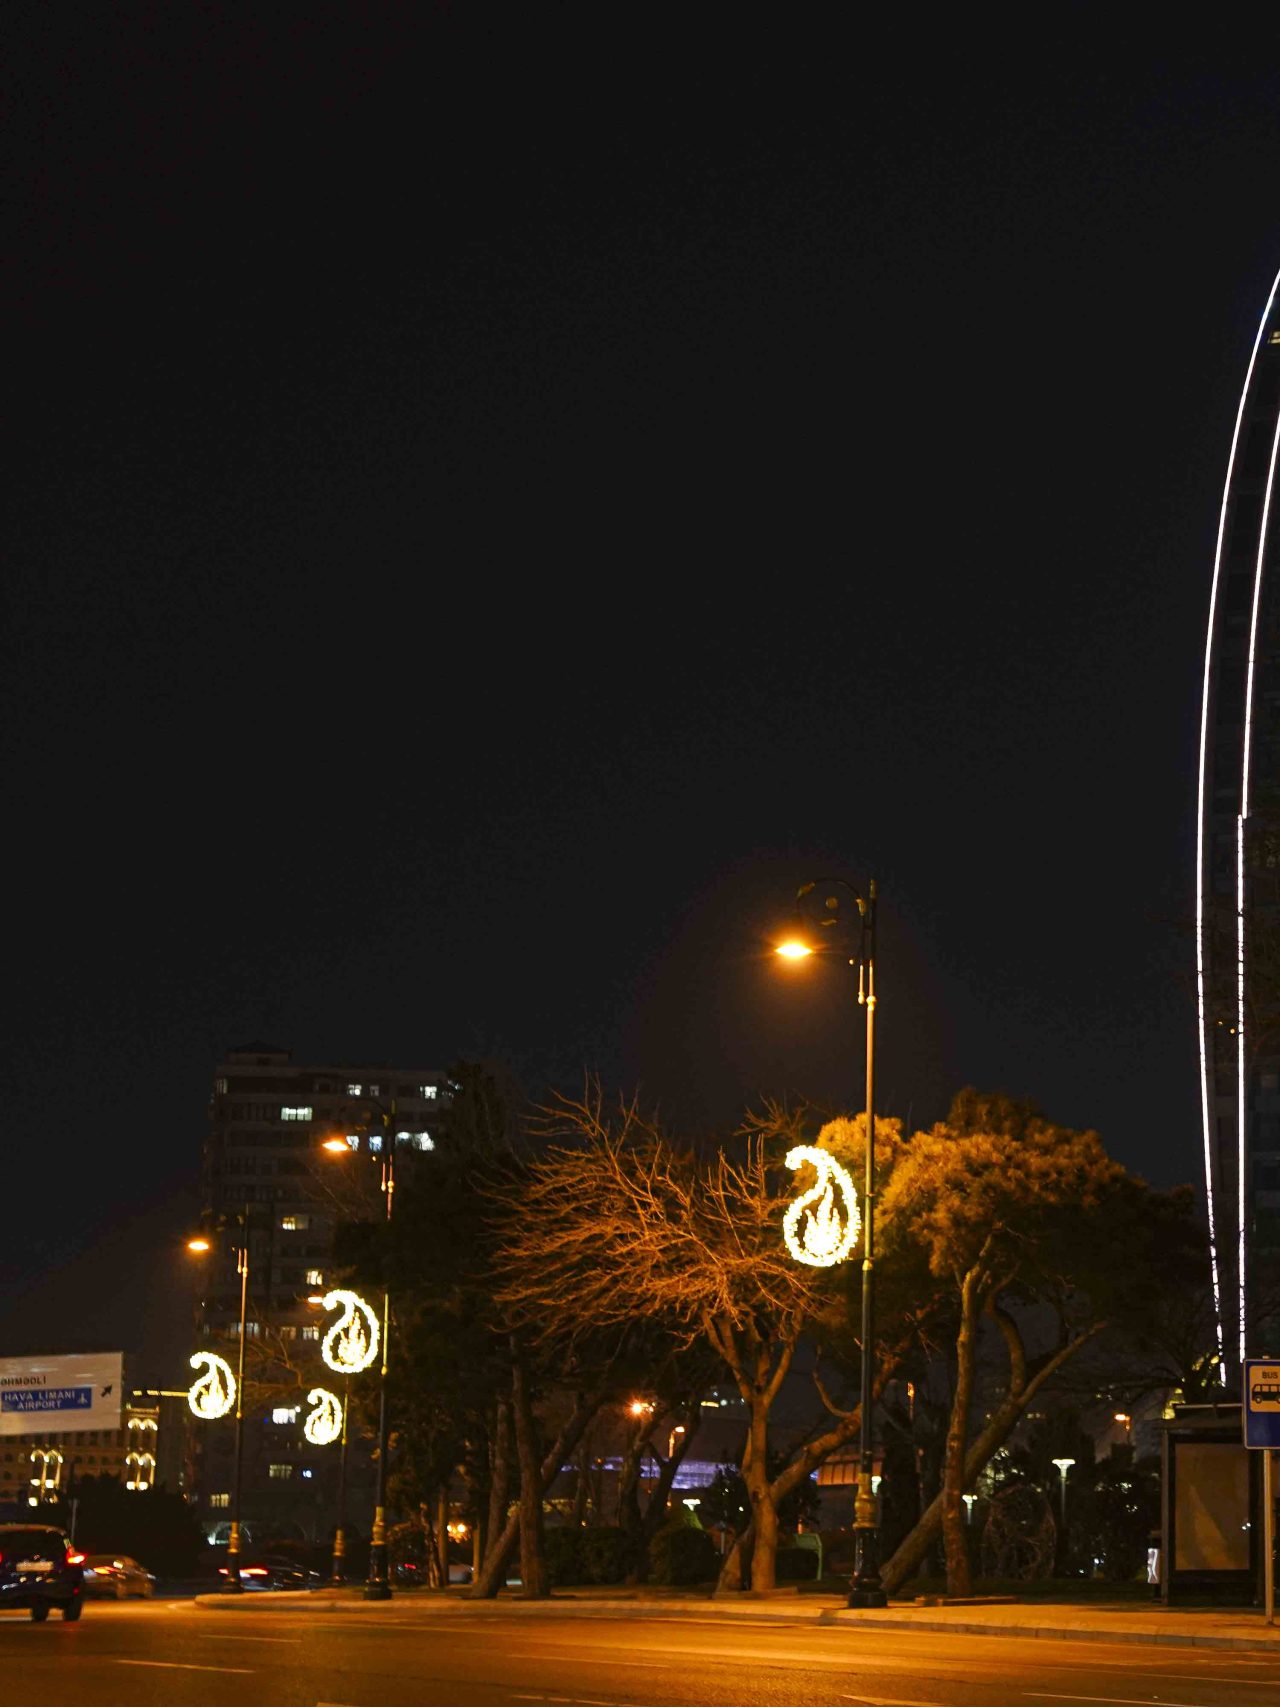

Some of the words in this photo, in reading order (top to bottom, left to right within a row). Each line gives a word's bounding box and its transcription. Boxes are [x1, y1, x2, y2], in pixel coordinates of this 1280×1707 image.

[1262, 1371, 1278, 1379] BUS
[5, 1391, 33, 1401] HAVA
[18, 1400, 62, 1410] AIRPORT
